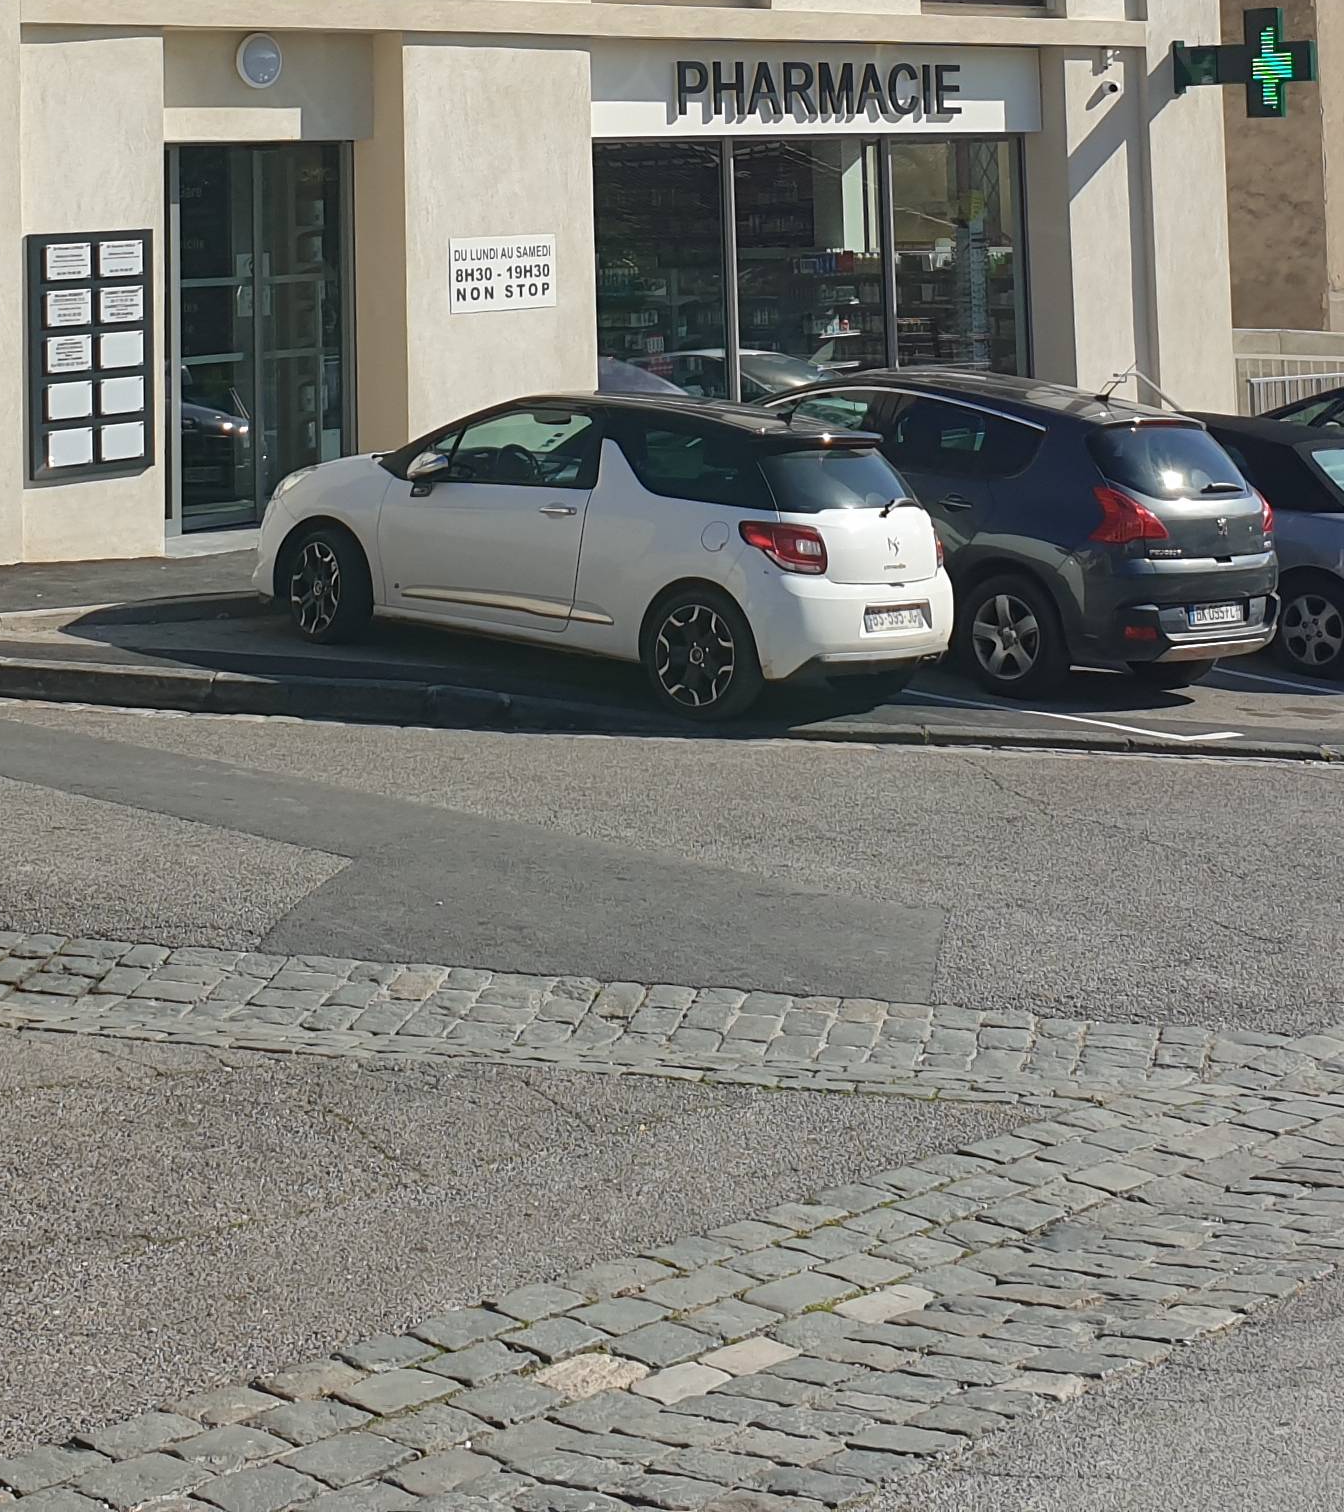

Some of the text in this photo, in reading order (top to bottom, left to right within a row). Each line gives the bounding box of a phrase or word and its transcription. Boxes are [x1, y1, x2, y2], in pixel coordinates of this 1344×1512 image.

[676, 60, 963, 115] PHARMACIE
[454, 244, 551, 261] DU LUNDI AU SAMEDI
[455, 267, 493, 283] 8H30
[506, 263, 550, 280] 19H30
[456, 282, 550, 301] NON STOP
